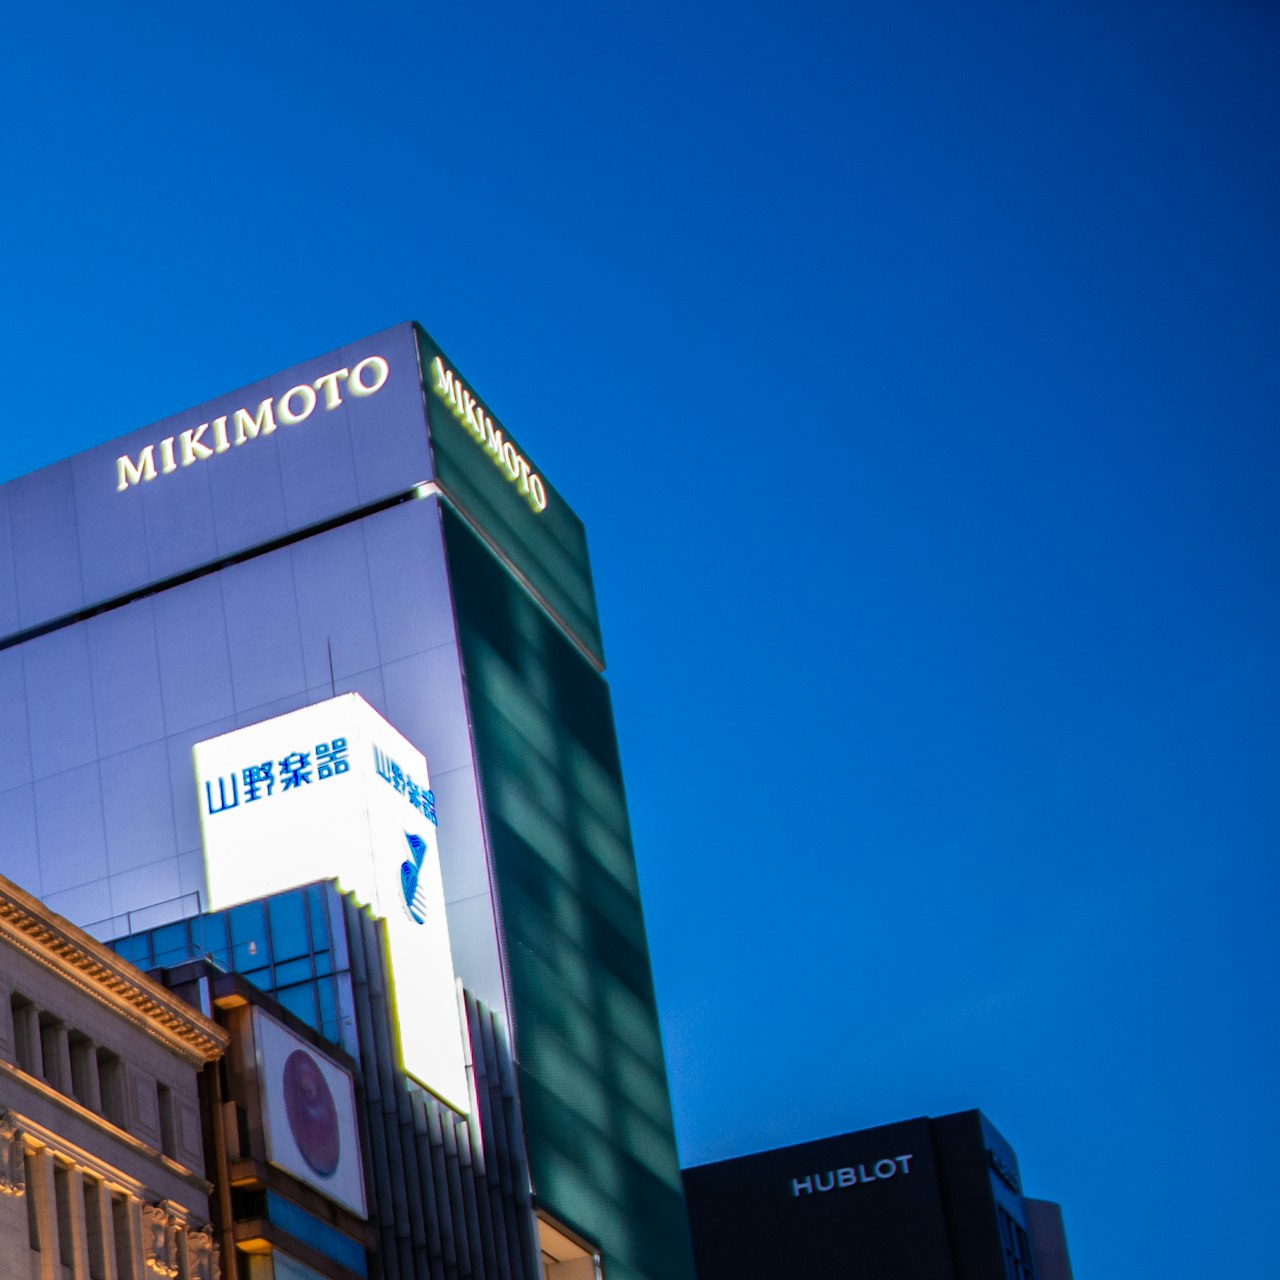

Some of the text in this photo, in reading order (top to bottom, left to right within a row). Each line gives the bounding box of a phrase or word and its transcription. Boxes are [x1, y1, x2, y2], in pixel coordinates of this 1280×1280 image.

[116, 355, 389, 492] MIKIMOTO
[431, 356, 547, 512] MIKIMOTO
[205, 737, 350, 815] 山野楽器
[372, 742, 438, 828] 山野楽器
[792, 1153, 913, 1197] HUBLOT
